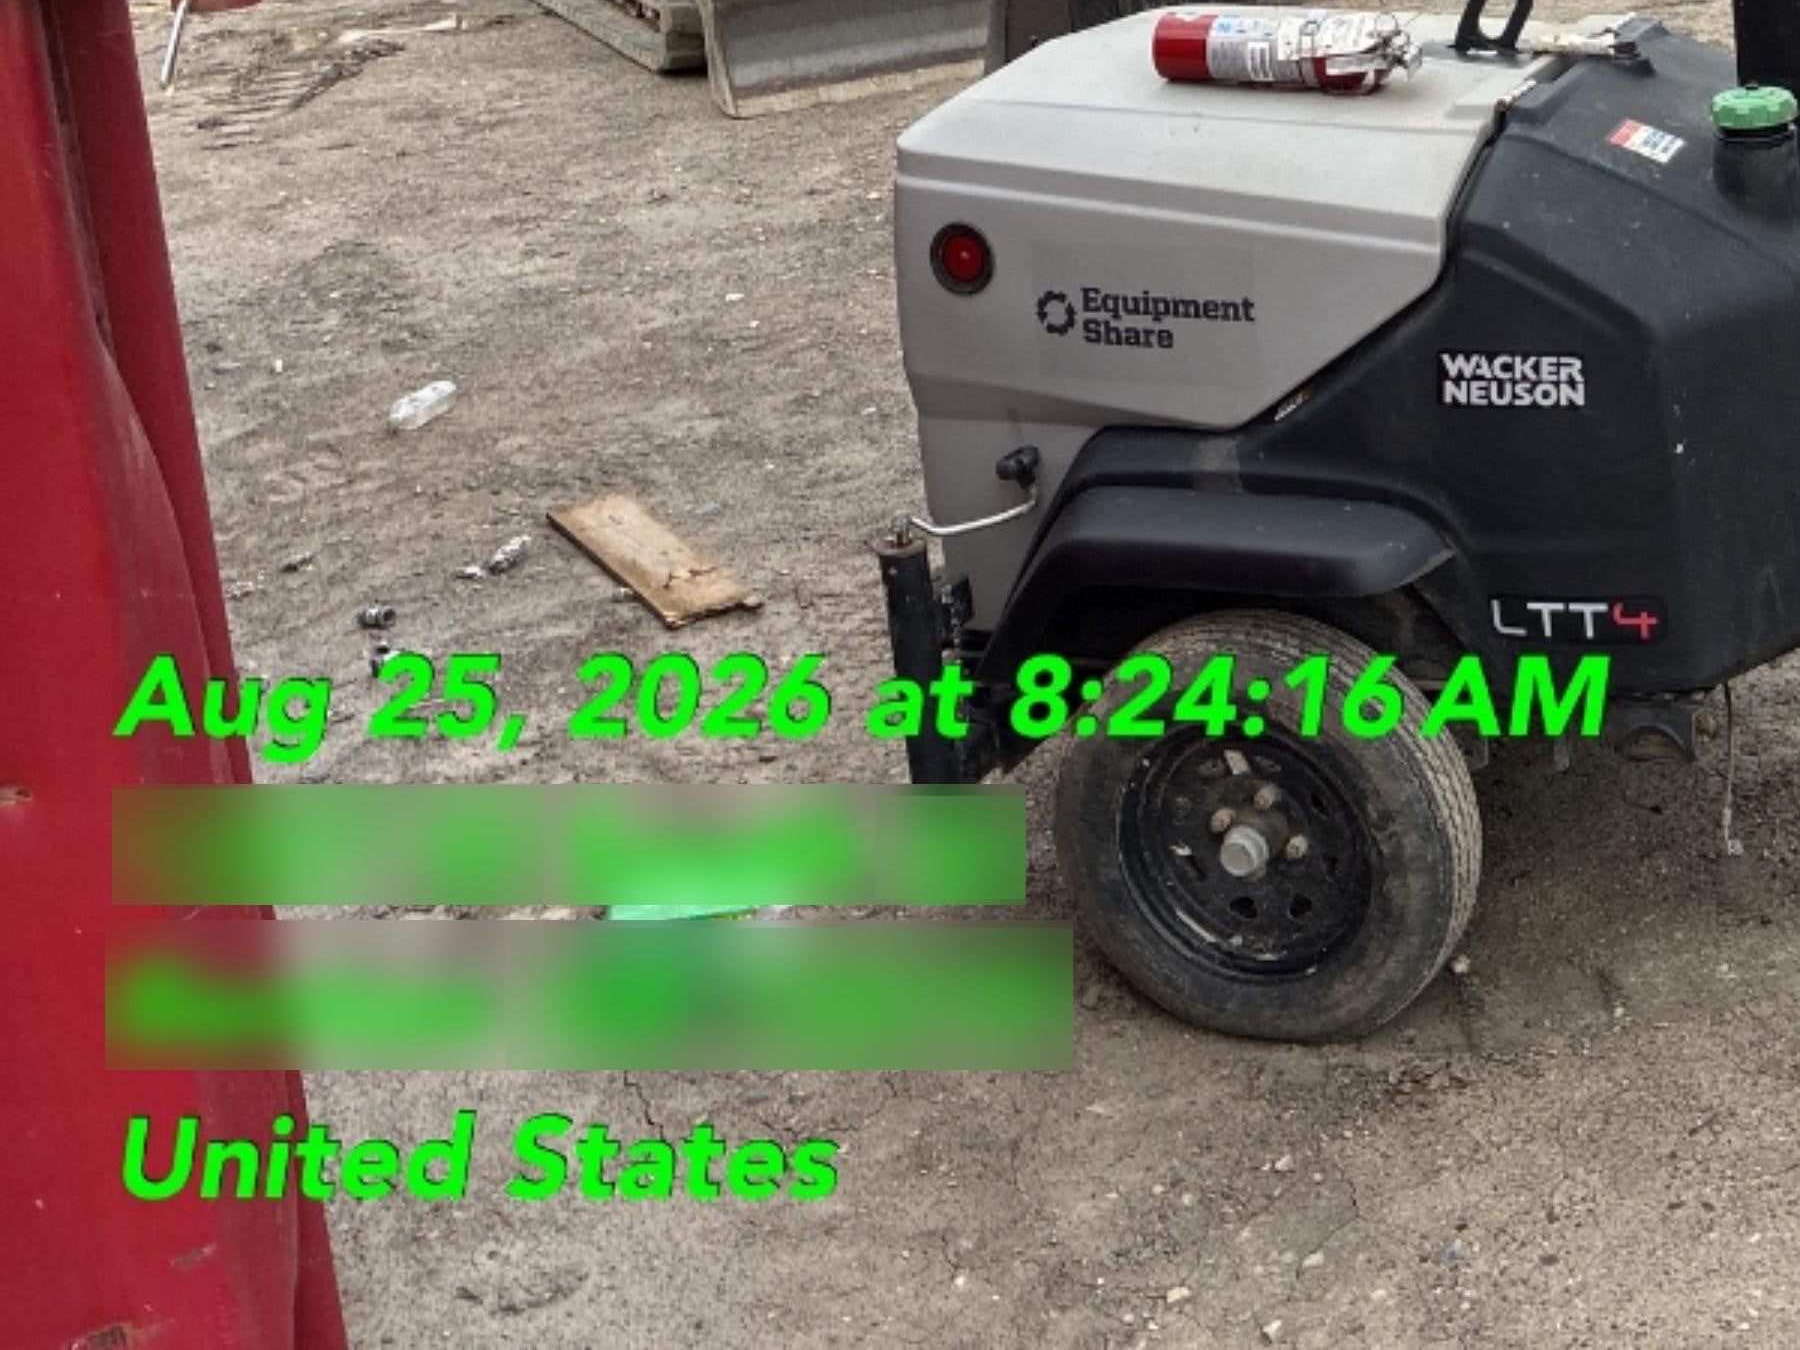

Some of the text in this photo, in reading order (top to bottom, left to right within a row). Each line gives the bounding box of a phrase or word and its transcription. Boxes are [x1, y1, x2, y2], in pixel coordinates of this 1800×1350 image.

[1080, 286, 1256, 323] Equipment
[1082, 317, 1174, 349] Share
[1439, 352, 1585, 383] WACKER
[1442, 379, 1586, 407] NEUSON
[1490, 599, 1658, 640] LTT4
